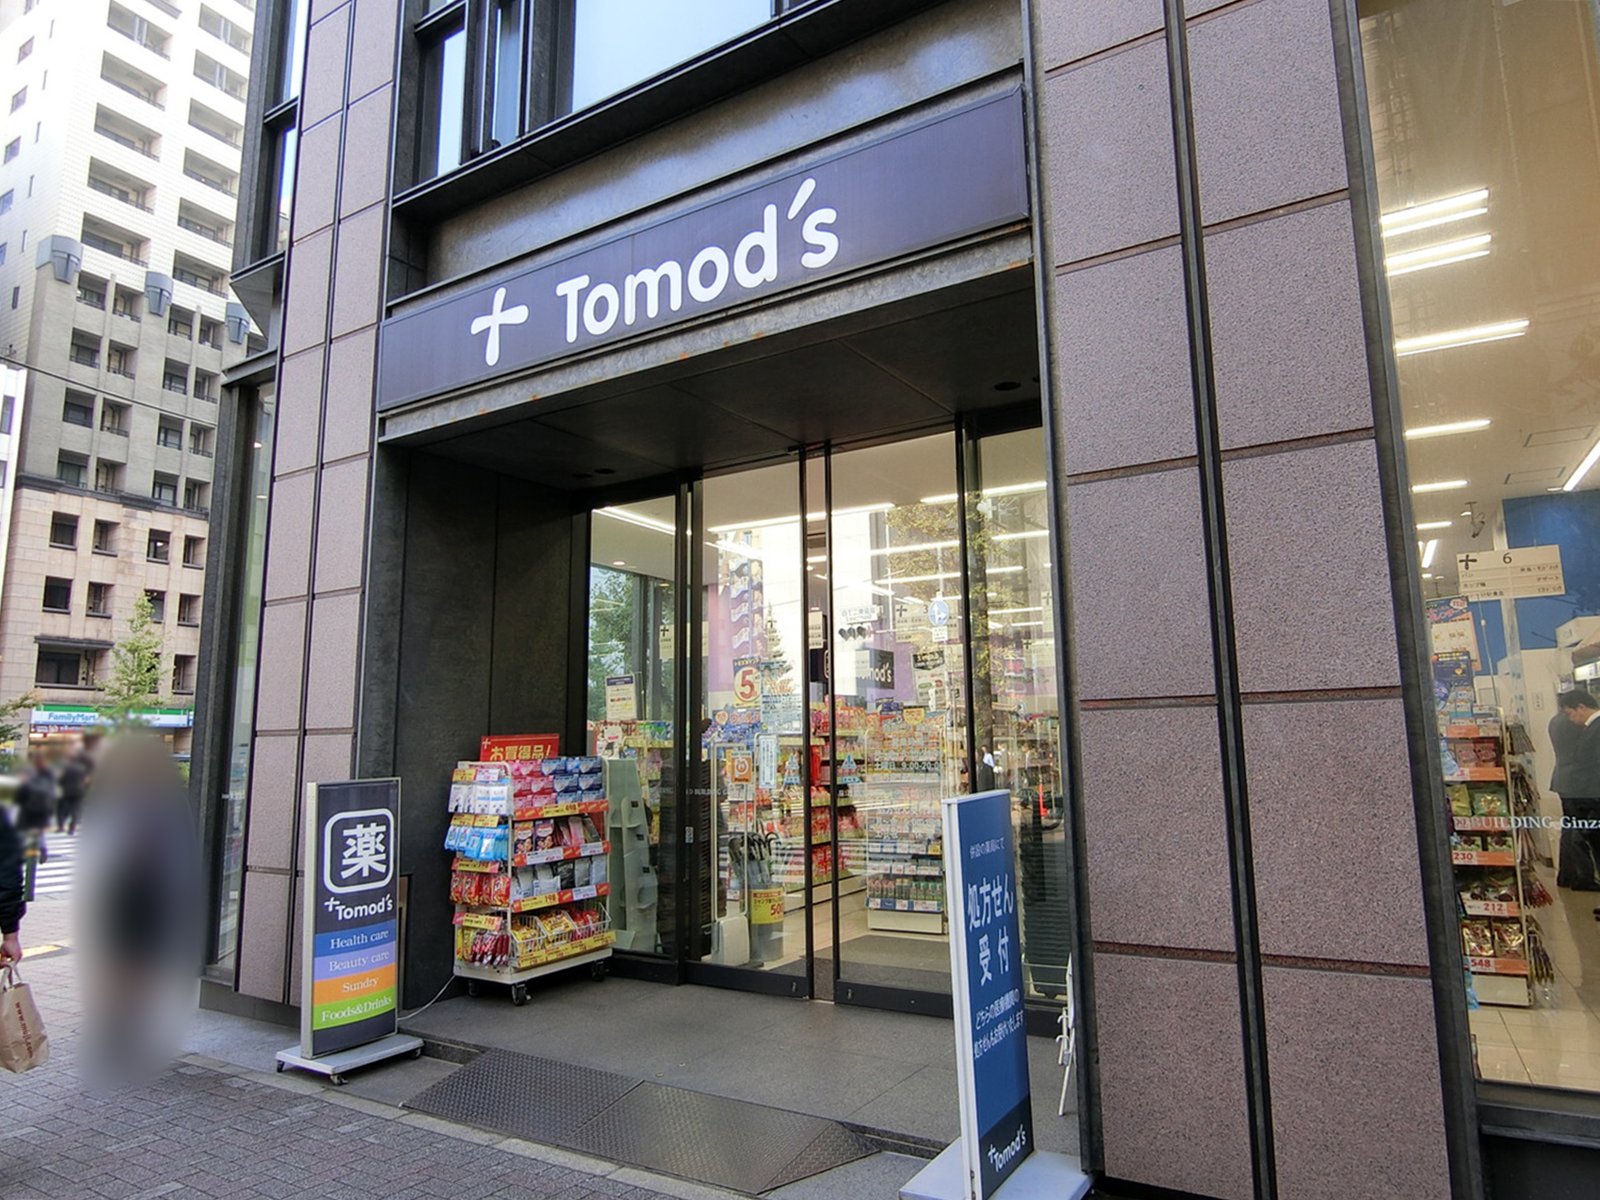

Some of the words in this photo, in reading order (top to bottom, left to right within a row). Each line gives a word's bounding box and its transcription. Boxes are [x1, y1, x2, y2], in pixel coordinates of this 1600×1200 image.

[556, 178, 839, 343] Tomod's
[1502, 552, 1512, 564] 6
[48, 712, 97, 722] FamilyMart
[1470, 815, 1551, 829] BUILDING
[341, 822, 387, 879] 薬
[1453, 852, 1473, 861] 230
[335, 894, 394, 921] Tomod's
[967, 873, 1014, 932] 処方せん
[1483, 903, 1503, 911] 212
[330, 934, 368, 949] Health
[370, 930, 389, 942] care
[329, 957, 369, 972] Beauty
[371, 951, 389, 964] care
[1471, 959, 1491, 968] 548
[342, 977, 378, 993] Sundry
[321, 996, 392, 1021] Foods&Drinks
[15, 1002, 34, 1059] www.muji.com
[994, 1124, 1026, 1172] Tomod's
